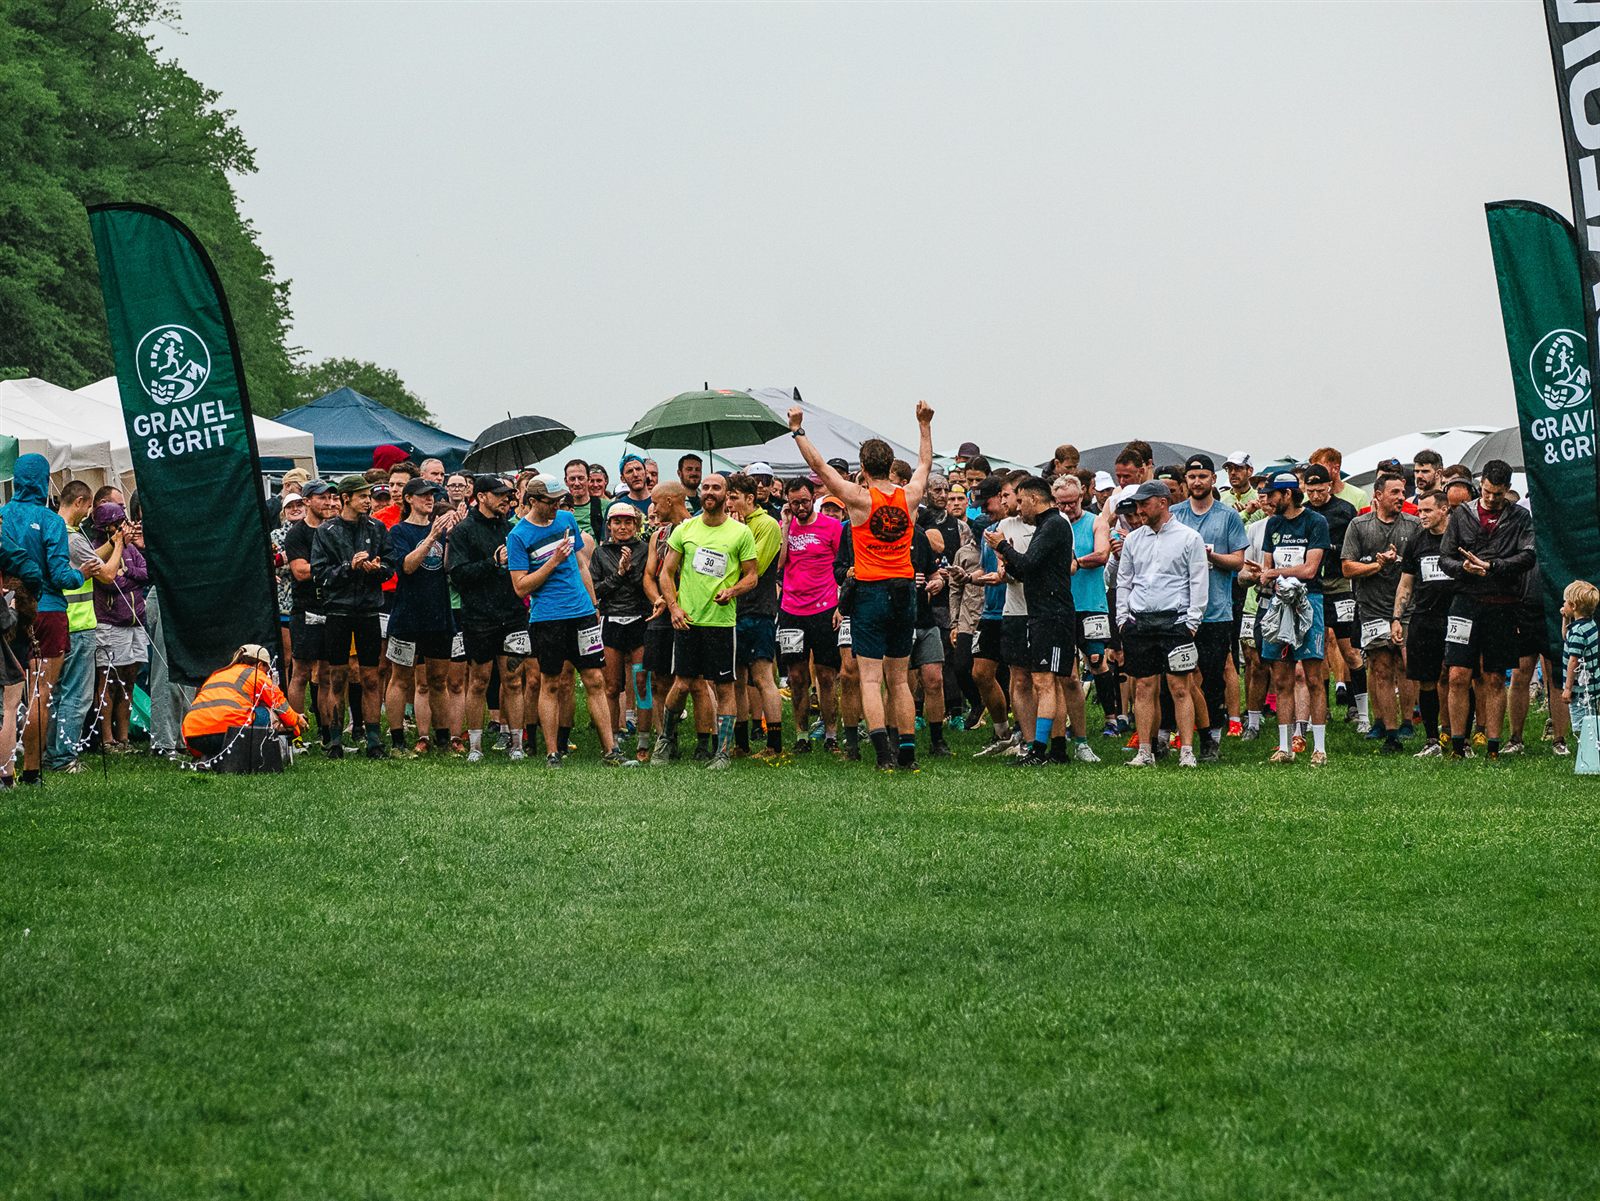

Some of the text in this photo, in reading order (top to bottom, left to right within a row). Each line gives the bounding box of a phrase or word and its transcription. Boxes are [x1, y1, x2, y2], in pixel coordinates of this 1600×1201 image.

[134, 400, 235, 436] GRAVEL
[1531, 409, 1595, 441] GRAV
[147, 424, 227, 459] & GRIT
[1544, 433, 1597, 464] & GRI
[704, 557, 715, 567] 30
[1283, 553, 1292, 562] 72
[1094, 623, 1103, 631] 79
[1369, 628, 1378, 636] 22
[516, 637, 526, 646] 32
[783, 637, 791, 645] 71
[1181, 652, 1190, 662] 35
